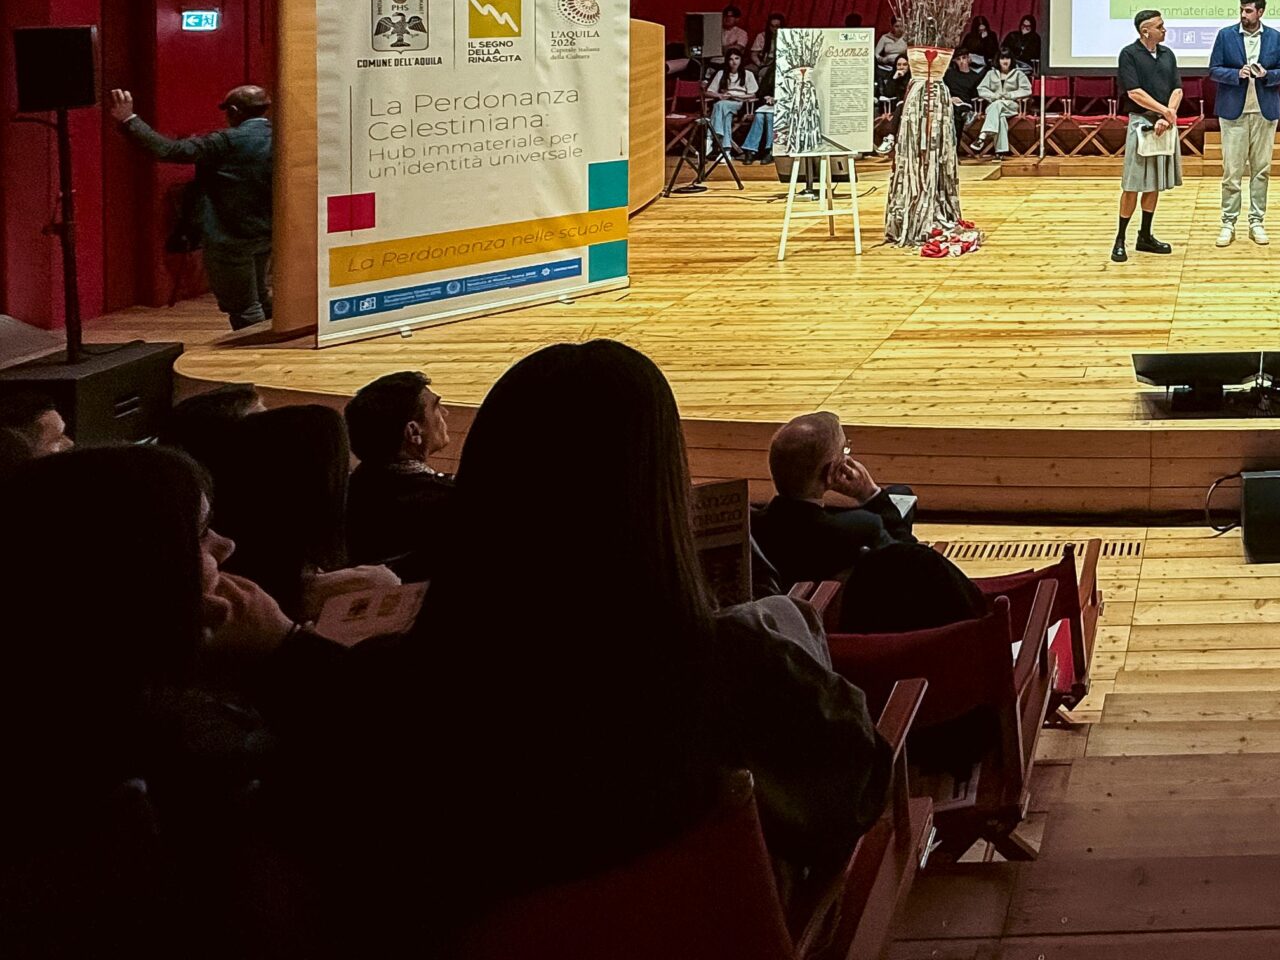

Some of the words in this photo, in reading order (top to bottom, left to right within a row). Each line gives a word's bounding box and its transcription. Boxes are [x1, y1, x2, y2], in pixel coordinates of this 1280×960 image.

[1160, 5, 1224, 16] mmateriale
[551, 30, 600, 40] L'AQUILA
[551, 38, 576, 46] 2026
[357, 58, 392, 68] COMUNE
[394, 56, 442, 68] DELL'AQUILA
[468, 56, 522, 64] RINASCITA
[370, 98, 402, 117] La
[414, 88, 580, 113] Perdonanza
[368, 112, 550, 141] Celestiniana:
[369, 144, 416, 161] Hub
[422, 134, 544, 156] immateriale
[550, 131, 578, 147] per
[369, 156, 483, 179] un'identità
[490, 146, 582, 167] universale
[347, 255, 374, 273] La
[382, 237, 507, 267] Perdonanza
[512, 228, 554, 248] nelle
[559, 220, 615, 240] scuole
